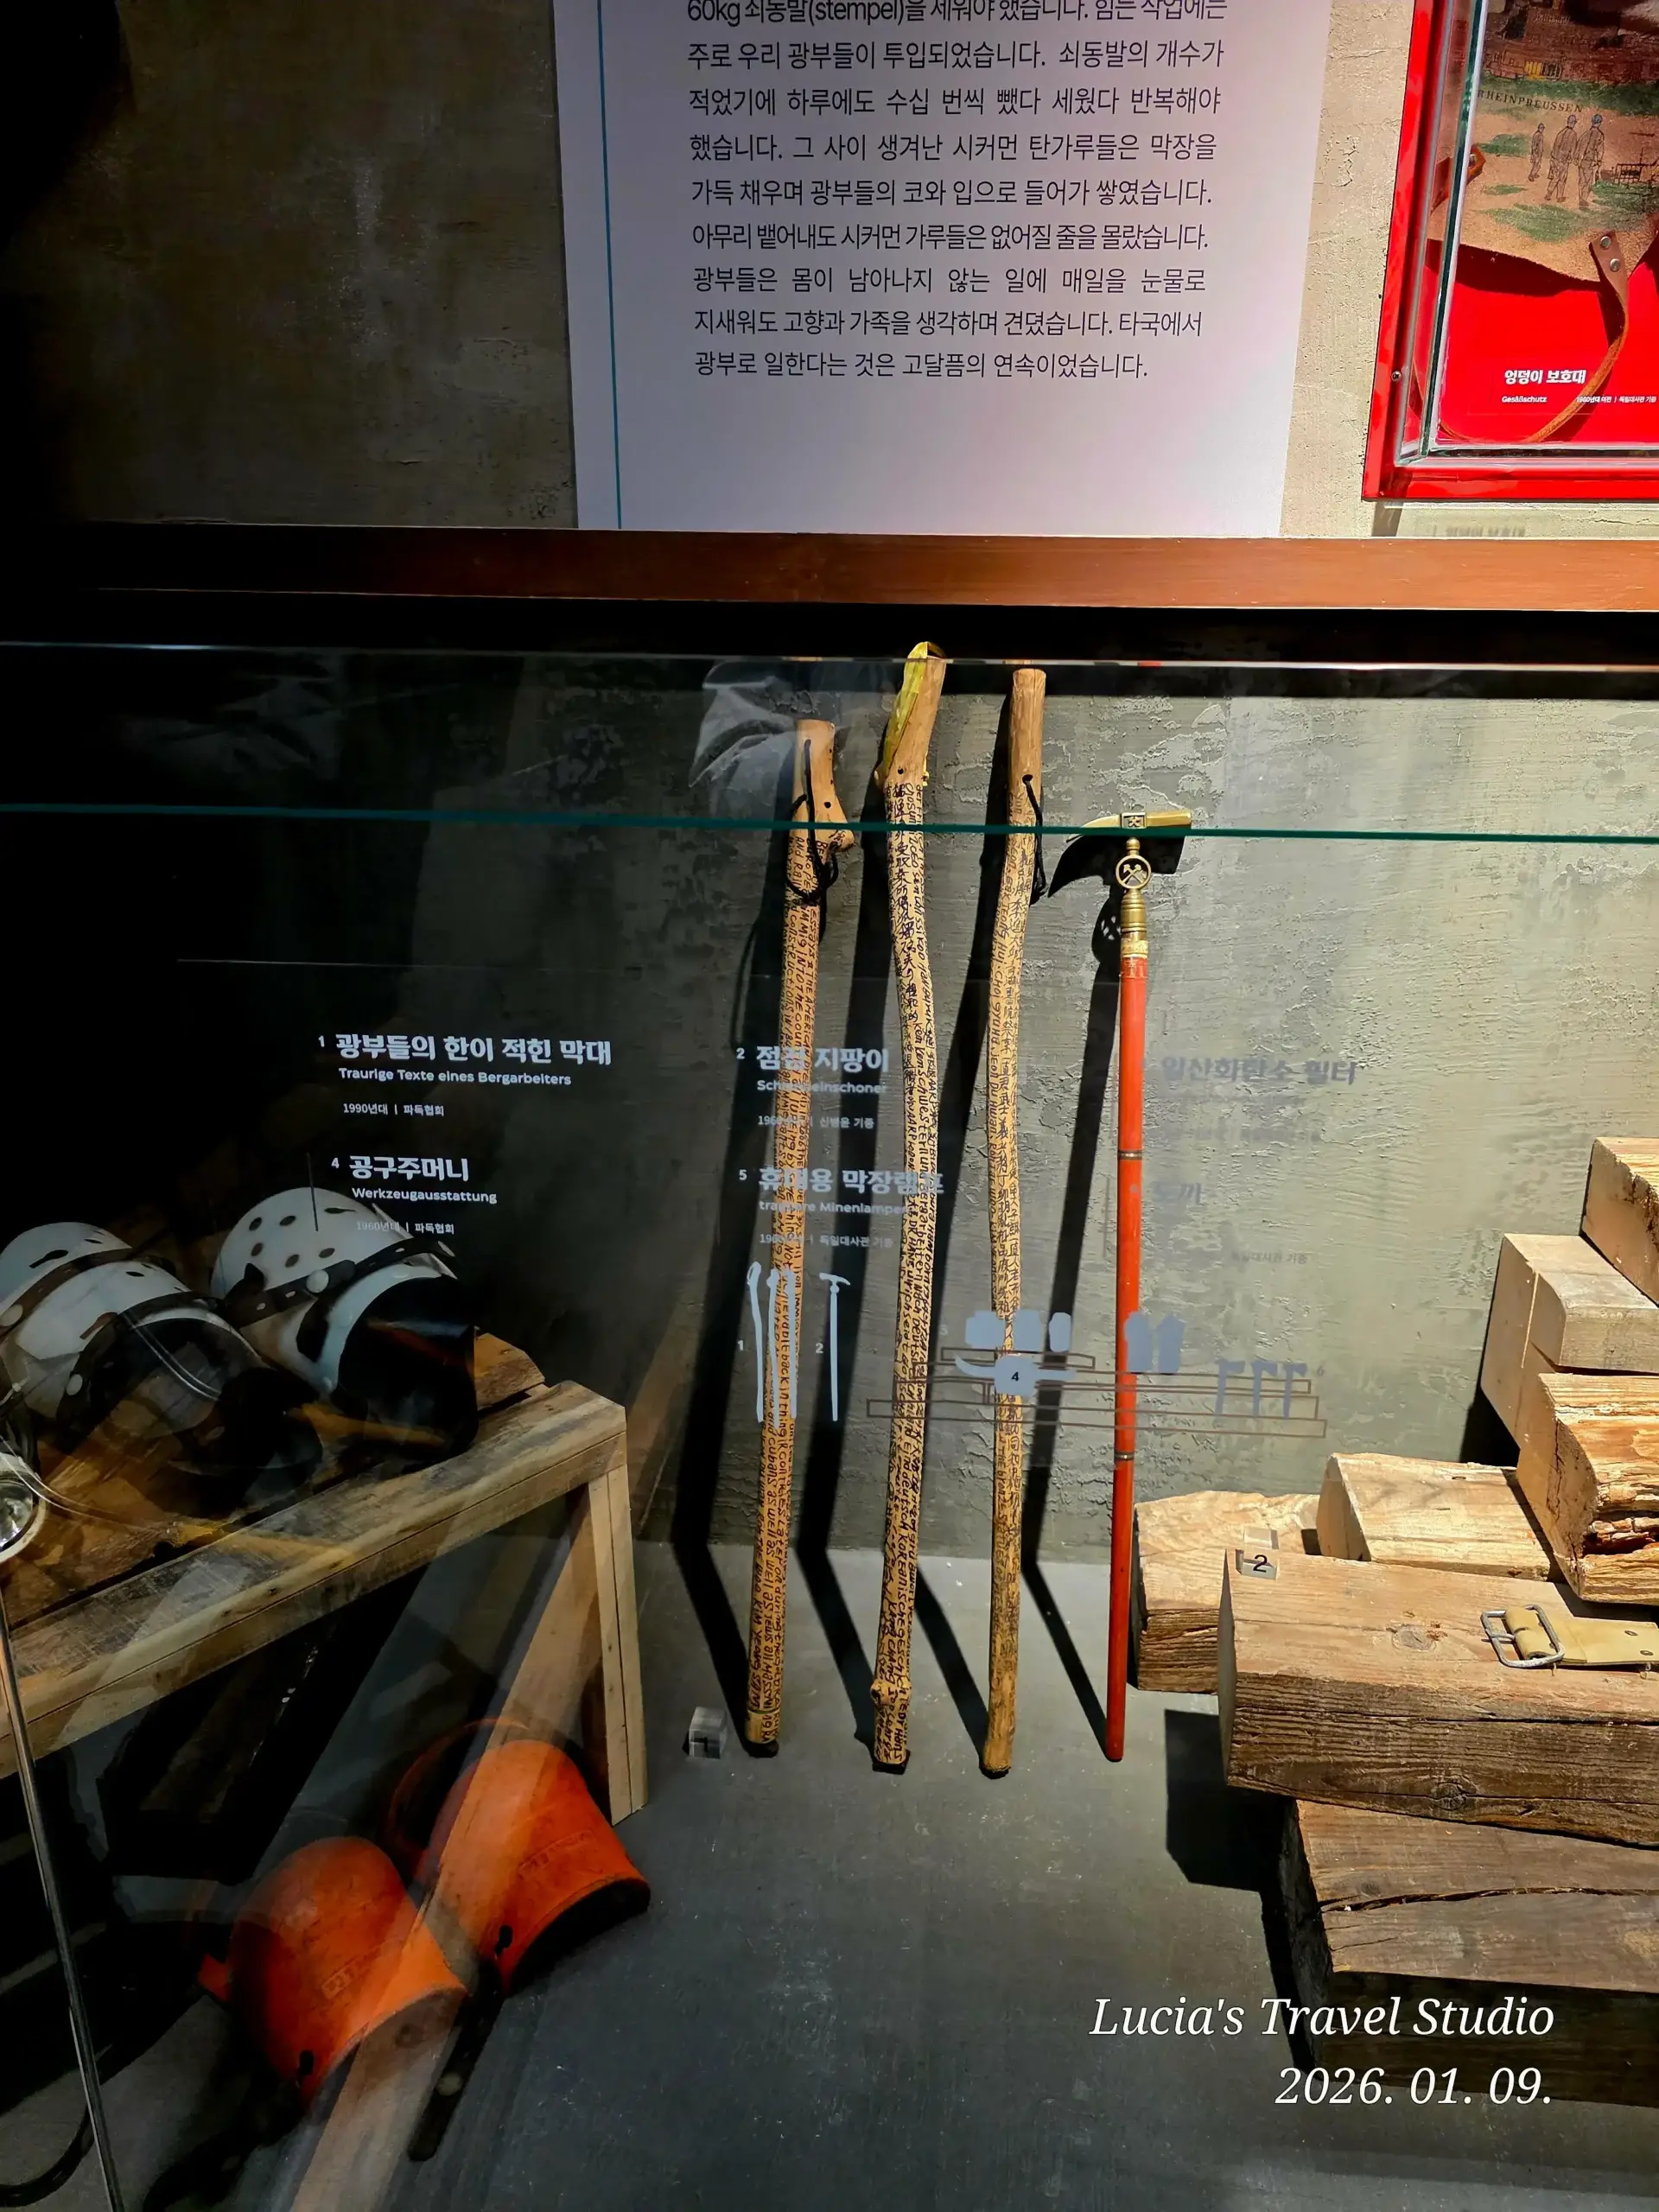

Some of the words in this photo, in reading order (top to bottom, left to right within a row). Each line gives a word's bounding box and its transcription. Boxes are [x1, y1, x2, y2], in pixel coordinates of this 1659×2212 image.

[688, 44, 732, 70] 주로
[738, 41, 779, 69] 우리
[788, 41, 874, 69] 광부들이
[883, 41, 1045, 69] 투입되었습니다.
[1059, 40, 1147, 68] 쇠동발의
[1156, 40, 1224, 67] 개수가
[690, 89, 775, 116] 적었기에
[787, 88, 874, 116] 하루에도
[887, 88, 928, 115] 수십
[943, 88, 983, 115] 번씩
[997, 87, 1041, 115] 뺐다
[1052, 87, 1119, 114] 세웠다
[1131, 86, 1221, 114] 반복해야
[690, 135, 782, 161] 했습니다.
[793, 137, 814, 157] 그
[824, 135, 865, 161] 사이
[878, 134, 943, 161] 생겨난
[953, 134, 1016, 161] 시커먼
[1030, 134, 1139, 161] 탄가루들은
[1151, 133, 1217, 160] 막장을
[692, 180, 734, 206] 가득
[740, 180, 802, 206] 채우며
[810, 180, 894, 206] 광부들의
[903, 180, 946, 206] 코와
[954, 180, 1017, 205] 입으로
[1024, 180, 1090, 206] 들어가
[1096, 179, 1211, 206] 쌓였습니다.
[693, 224, 751, 250] 아무리
[758, 224, 836, 249] 뱉어내도
[841, 224, 900, 249] 시커먼
[906, 225, 987, 250] 가루들은
[991, 224, 1051, 250] 없어질
[1056, 225, 1097, 250] 줄을
[1102, 224, 1208, 250] 몰랐습니다.
[694, 267, 778, 292] 광부들은
[792, 267, 832, 292] 몸이
[849, 268, 931, 293] 남아나지
[949, 268, 990, 293] 않는
[1006, 268, 1046, 293] 일에
[1063, 268, 1126, 293] 매일을
[1141, 269, 1205, 293] 눈물로
[695, 309, 778, 334] 지새워도
[784, 309, 845, 335] 고향과
[850, 310, 911, 335] 가족을
[916, 311, 997, 335] 생각하며
[1004, 311, 1112, 336] 견뎠습니다.
[1120, 311, 1201, 336] 타국에서
[696, 351, 757, 376] 광부로
[765, 352, 847, 377] 일한다는
[855, 353, 895, 377] 것은
[902, 353, 984, 378] 고달픔의
[995, 353, 1147, 378] 연속이었습니다.
[1504, 370, 1543, 385] 엉덩이
[1546, 370, 1586, 384] 보호대
[319, 1036, 325, 1047] 1
[335, 1033, 435, 1060] 광부들의
[443, 1036, 493, 1063] 한이
[502, 1038, 552, 1064] 적힌
[559, 1039, 612, 1065] 막대
[736, 1048, 745, 1059] 2
[815, 1046, 890, 1072] 지팡이
[339, 1067, 393, 1082] Traurige
[397, 1069, 434, 1081] Texte
[438, 1071, 474, 1082] eines
[478, 1071, 572, 1085] Bergarbeiters
[343, 1103, 388, 1116] 1990년대
[404, 1104, 444, 1116] 파독협회
[331, 1158, 340, 1168] 4
[349, 1155, 469, 1182] 공구주머니
[739, 1169, 747, 1180] 5
[352, 1187, 497, 1205] Werkzeugausstattung
[415, 1223, 454, 1235] 파독협회
[816, 1343, 823, 1354] 2
[1011, 1372, 1020, 1382] 4
[1253, 1554, 1268, 1573] 2
